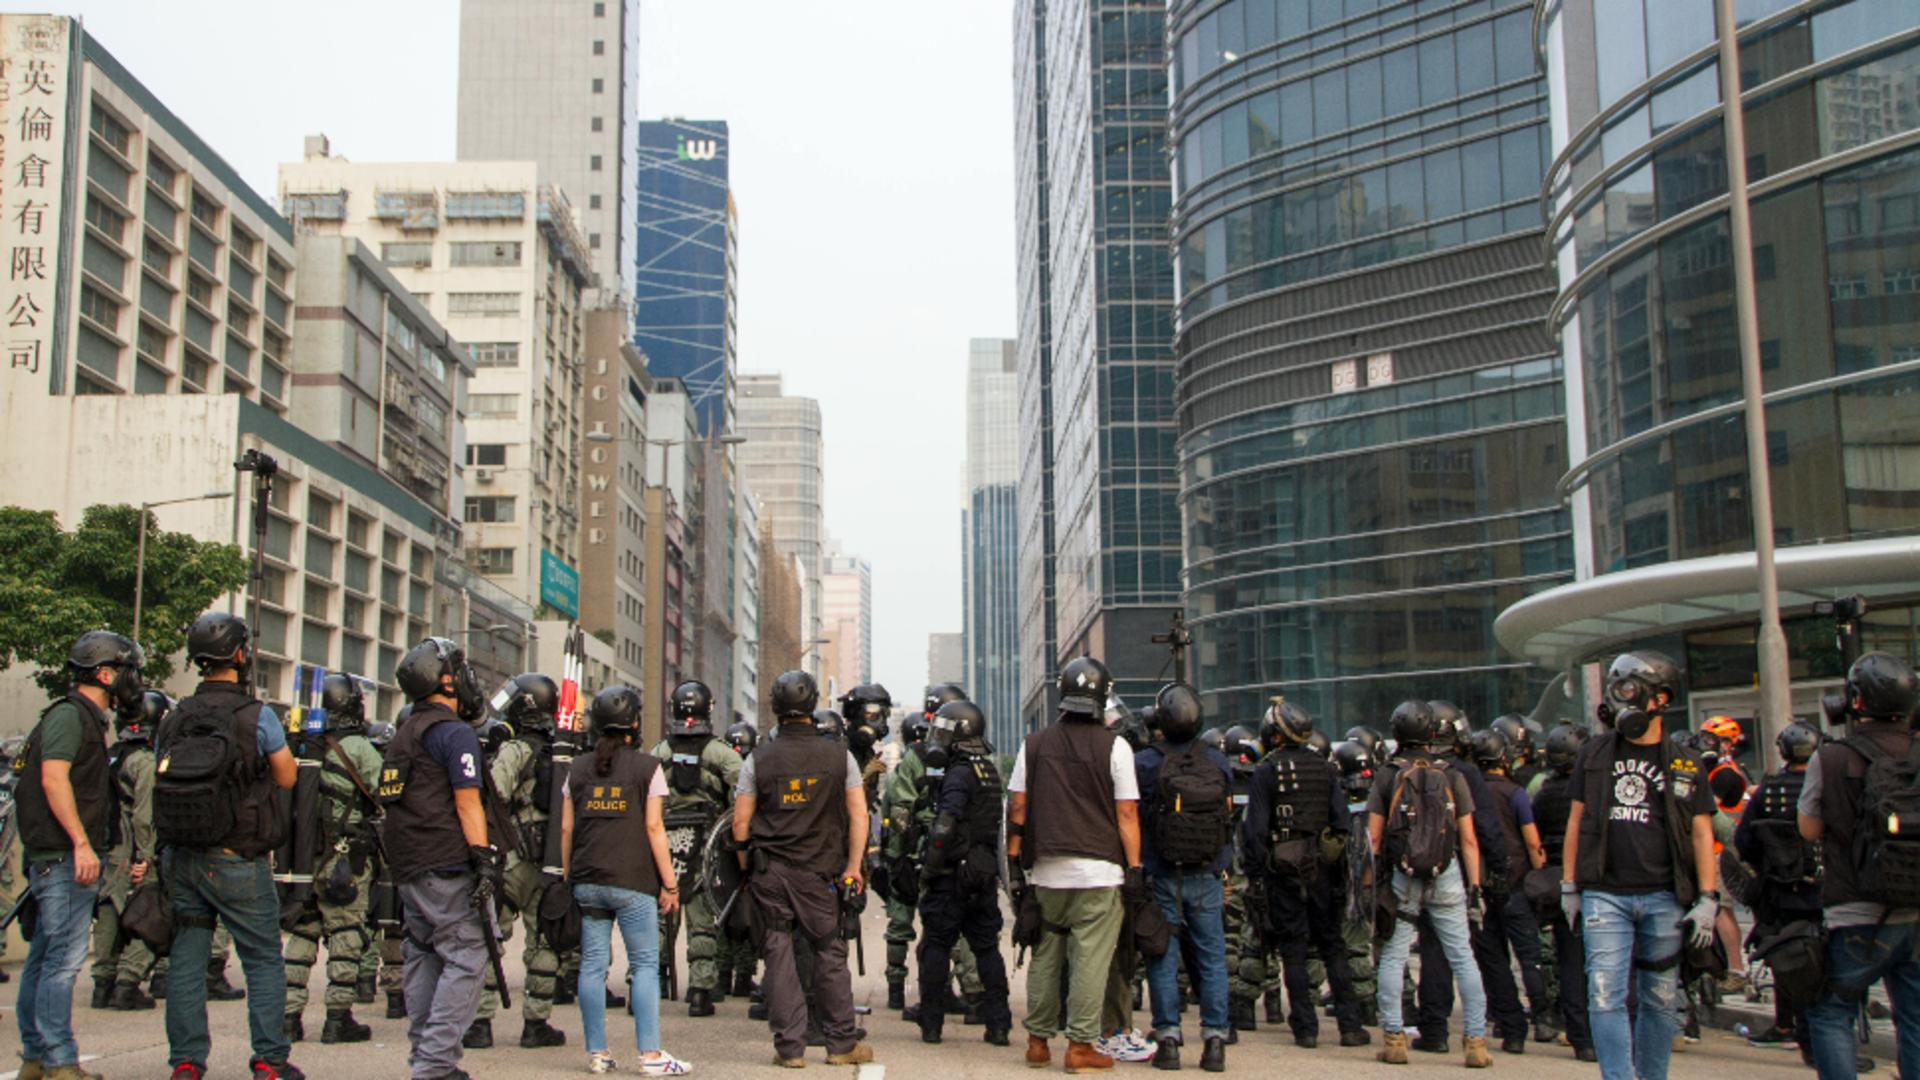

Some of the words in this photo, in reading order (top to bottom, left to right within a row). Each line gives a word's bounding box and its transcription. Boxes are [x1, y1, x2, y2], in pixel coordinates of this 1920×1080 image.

[6, 60, 56, 375] 英倫倉有限公司
[461, 752, 475, 778] 3
[1612, 759, 1665, 791] OOKLY
